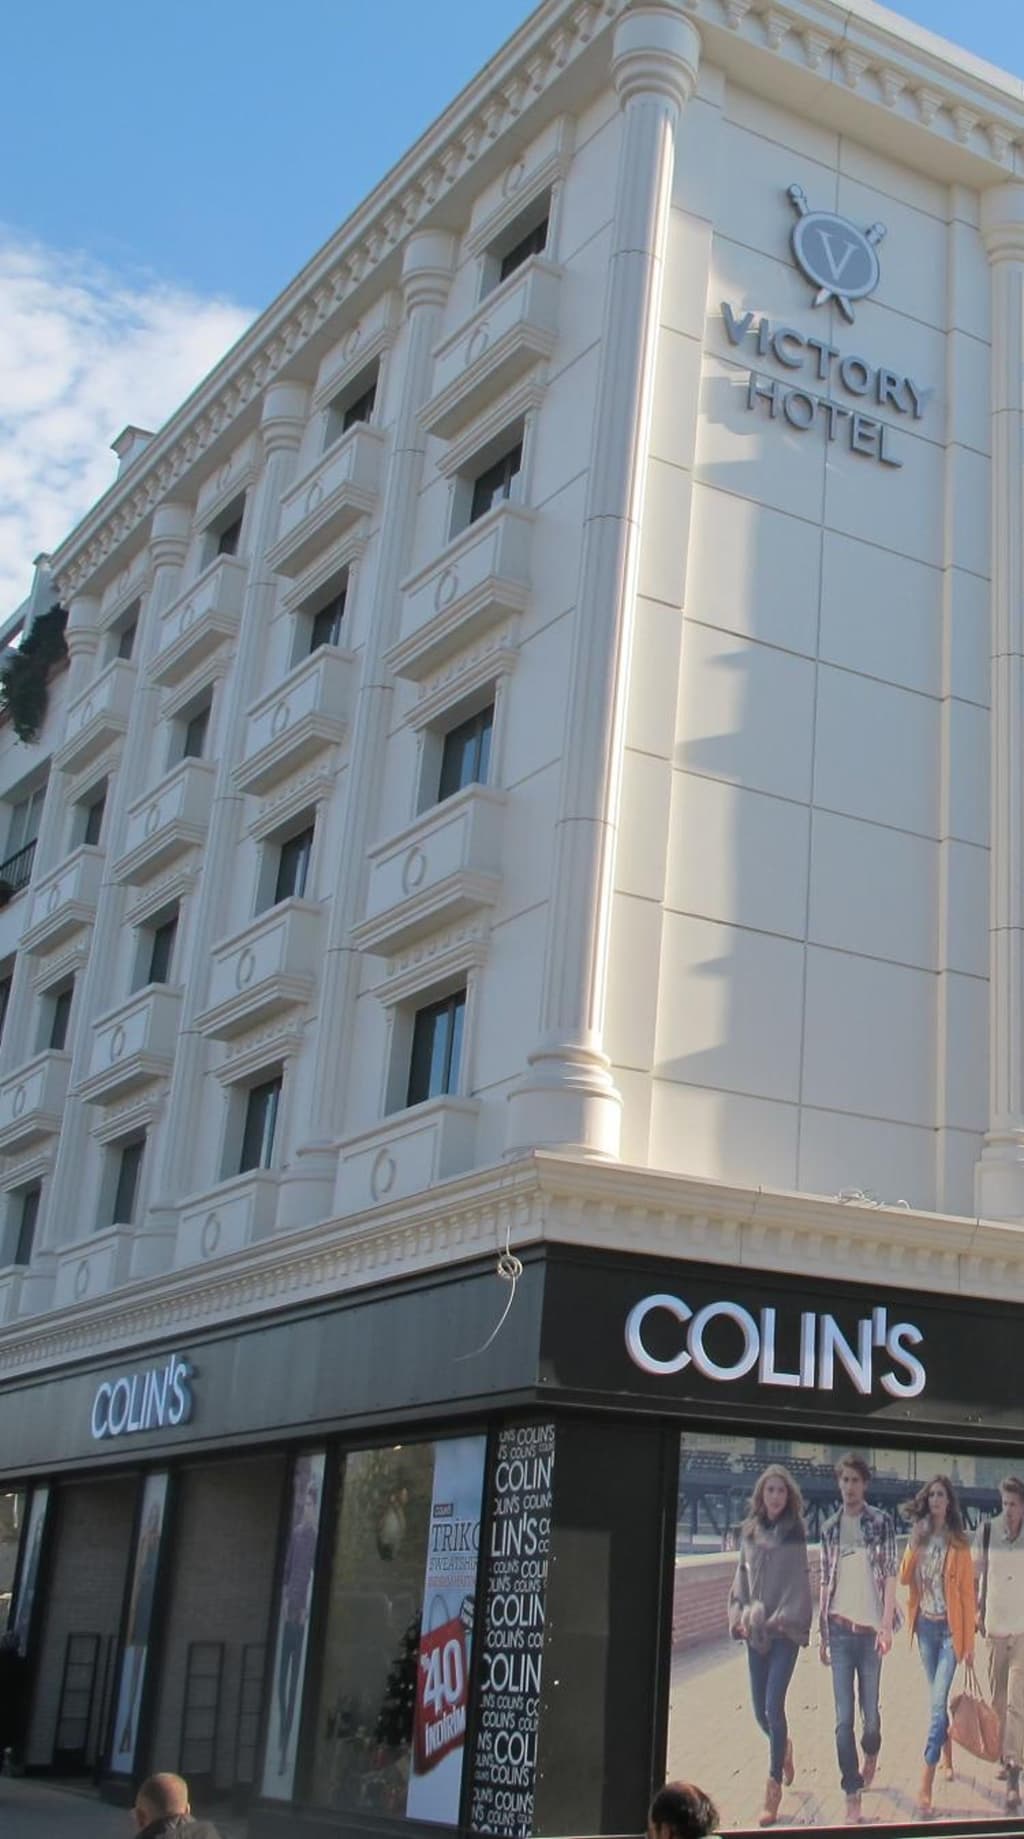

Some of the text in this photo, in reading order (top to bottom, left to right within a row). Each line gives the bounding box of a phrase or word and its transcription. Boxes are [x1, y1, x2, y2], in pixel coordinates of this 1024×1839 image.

[817, 229, 858, 280] V
[720, 301, 935, 420] VICTORY
[746, 370, 903, 469] HOTEL
[624, 1294, 926, 1398] COLIN'S
[91, 1354, 189, 1439] COLIN'S
[491, 1511, 538, 1557] LIN'S
